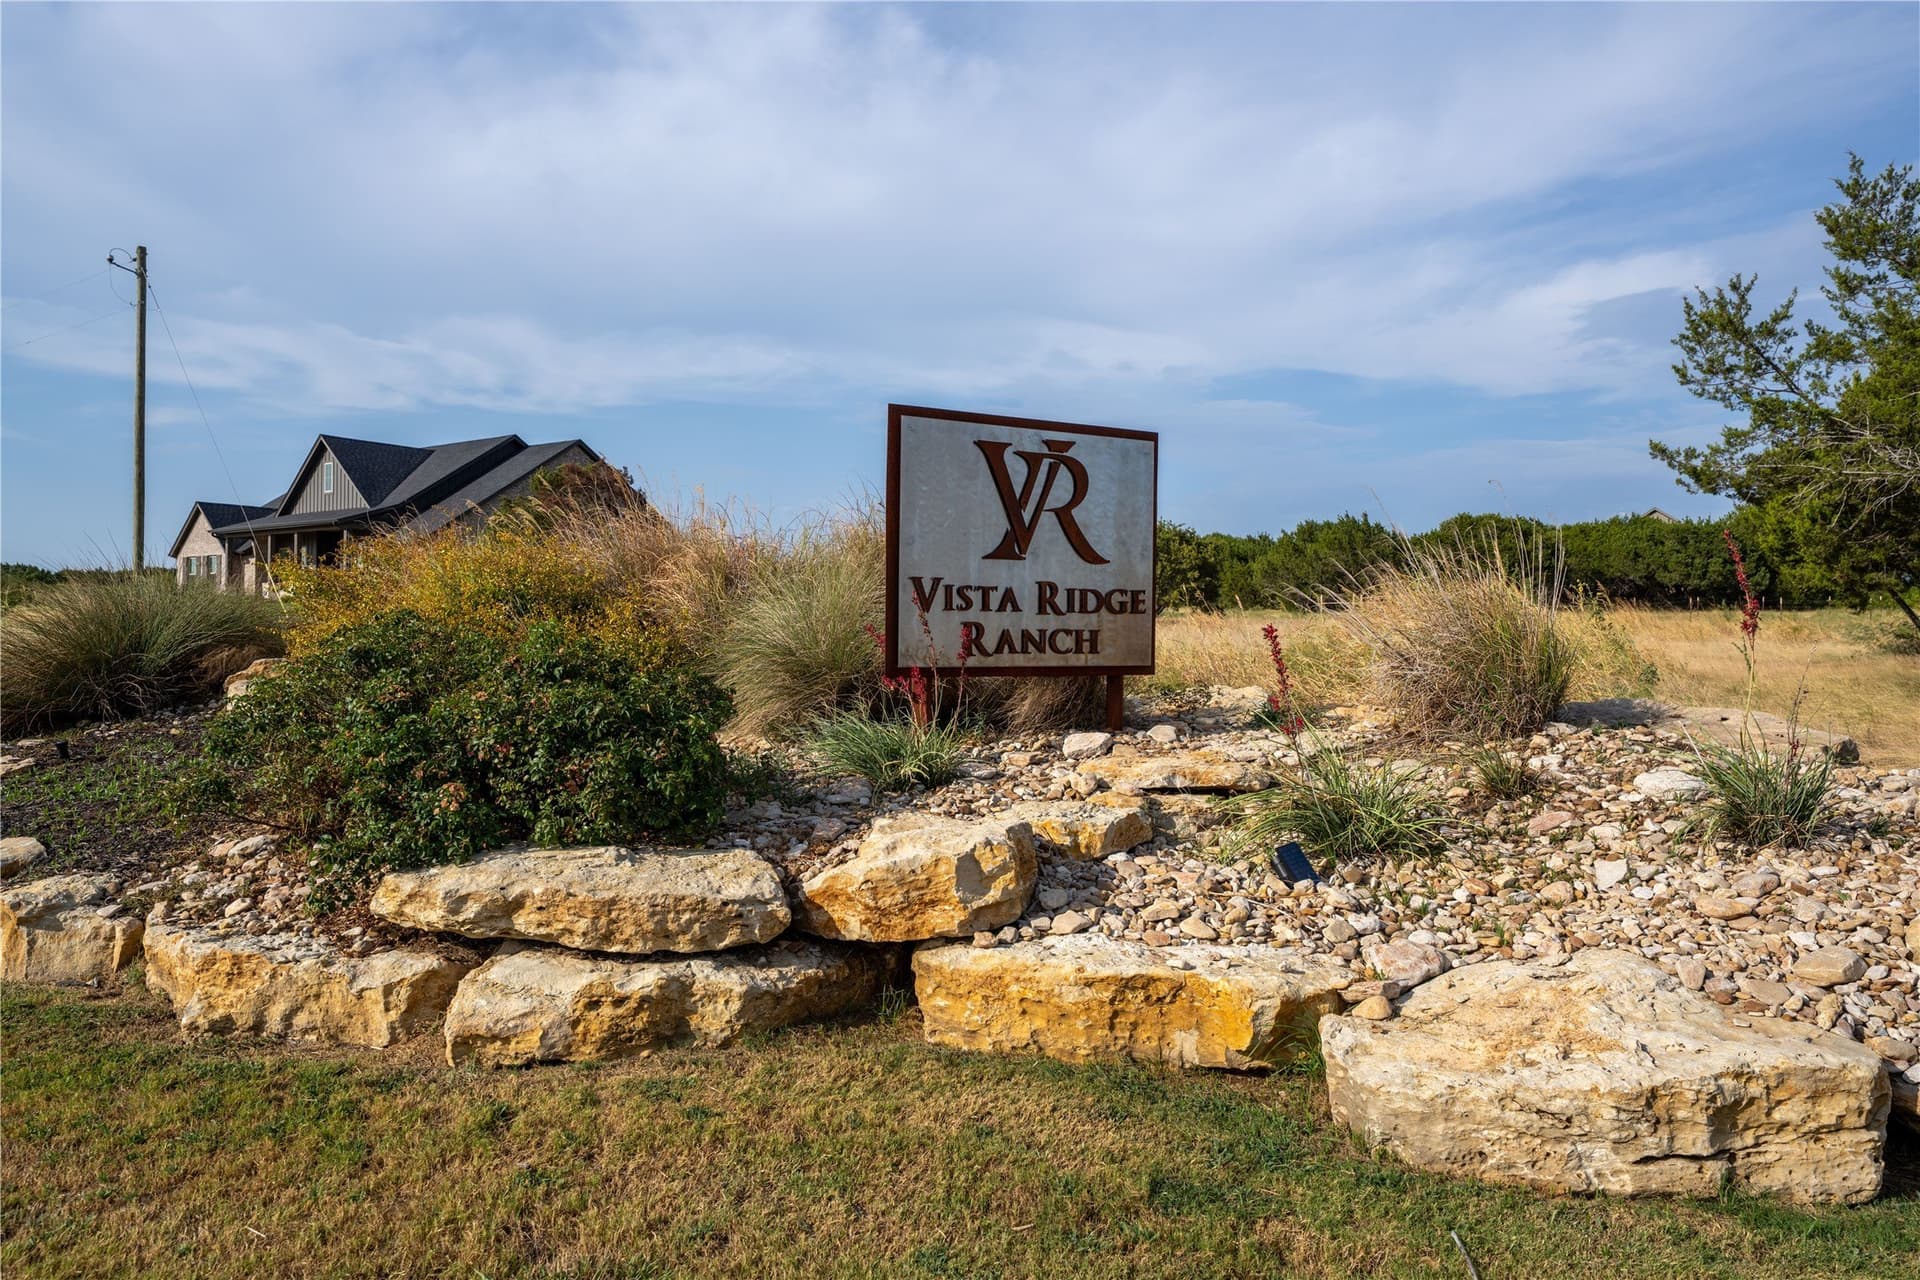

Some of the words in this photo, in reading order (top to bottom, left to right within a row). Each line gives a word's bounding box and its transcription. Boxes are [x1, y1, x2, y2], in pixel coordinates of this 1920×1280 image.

[908, 576, 1023, 613] VISTA
[1035, 581, 1147, 616] RIDGE
[960, 621, 1100, 657] RANCH
